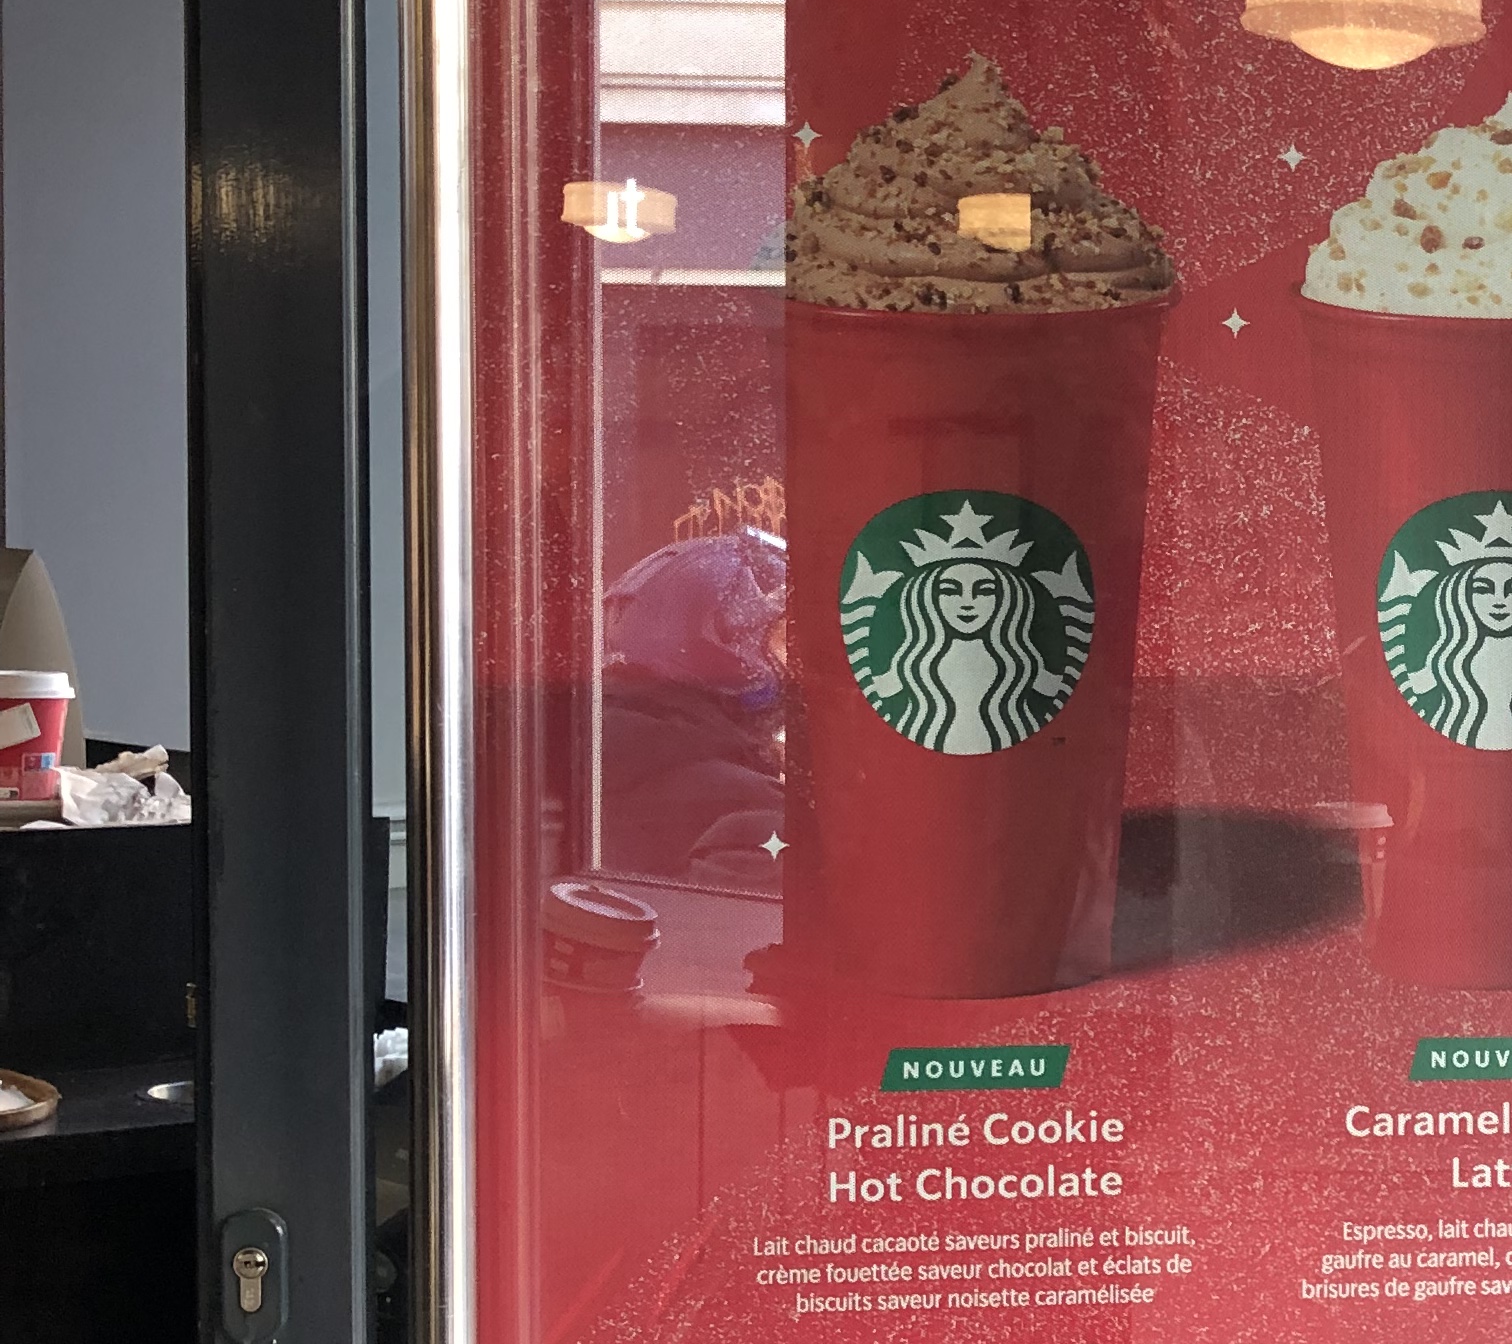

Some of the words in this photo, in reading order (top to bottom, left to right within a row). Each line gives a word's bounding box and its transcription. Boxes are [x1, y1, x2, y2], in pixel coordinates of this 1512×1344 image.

[903, 1058, 1048, 1080] NOUVEAU
[828, 1113, 971, 1149] Praliné
[983, 1110, 1126, 1145] Cookie
[1345, 1102, 1511, 1137] Caramel
[829, 1169, 903, 1203] Hot
[915, 1164, 1124, 1201] Chocolate
[753, 1236, 791, 1257] Lait
[794, 1234, 858, 1256] chaud
[862, 1232, 940, 1254] cacaoté
[945, 1233, 1020, 1253] saveurs
[1025, 1228, 1095, 1255] praliné
[1099, 1229, 1119, 1248] et
[1125, 1226, 1196, 1250] biscuit,
[1342, 1221, 1434, 1244] Espresso,
[1438, 1218, 1469, 1240] lait
[756, 1266, 821, 1286] crème
[826, 1261, 913, 1283] fouettée
[918, 1264, 983, 1282] saveur
[988, 1258, 1073, 1280] chocolat
[1078, 1259, 1099, 1277] et
[1103, 1255, 1162, 1277] éclats
[1166, 1254, 1193, 1275] de
[1321, 1249, 1385, 1275] gaufre
[1388, 1252, 1412, 1269] au
[1416, 1247, 1501, 1270] caramel,
[796, 1291, 873, 1314] biscuits
[877, 1293, 943, 1312] saveur
[948, 1288, 1031, 1310] noisette
[1035, 1284, 1155, 1307] caramélisée
[1301, 1278, 1380, 1300] brisures
[1384, 1278, 1410, 1299] de
[1414, 1276, 1477, 1302] gaufre
